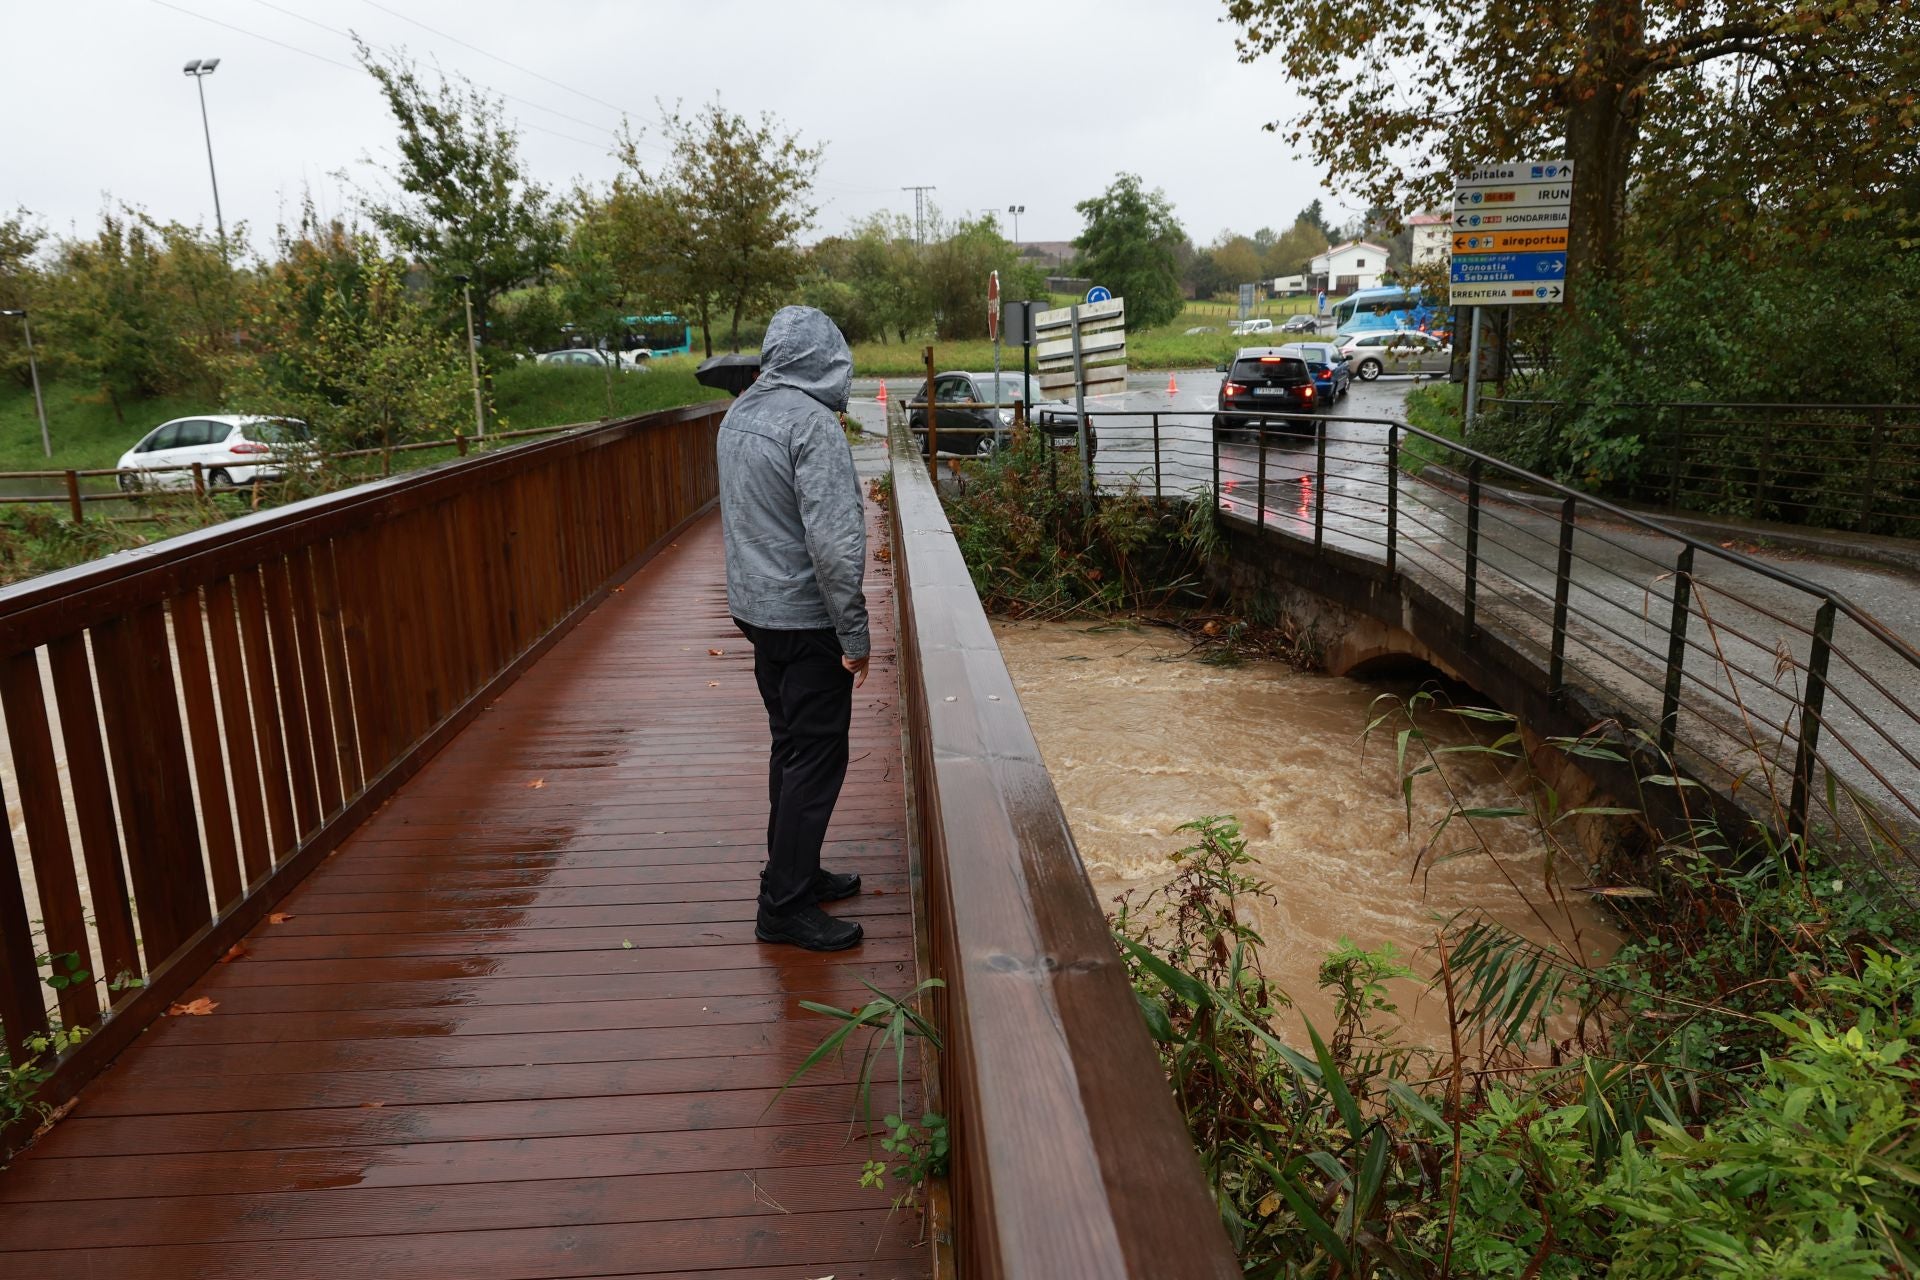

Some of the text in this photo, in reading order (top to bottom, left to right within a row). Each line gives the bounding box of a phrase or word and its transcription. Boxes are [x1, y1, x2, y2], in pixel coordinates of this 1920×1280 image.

[1538, 189, 1569, 200] IRUN
[1505, 213, 1567, 223] HONDARRIBIA
[1502, 235, 1566, 246] aireportua
[1461, 263, 1506, 271] Donostia
[1452, 290, 1507, 298] ERRENTERIA
